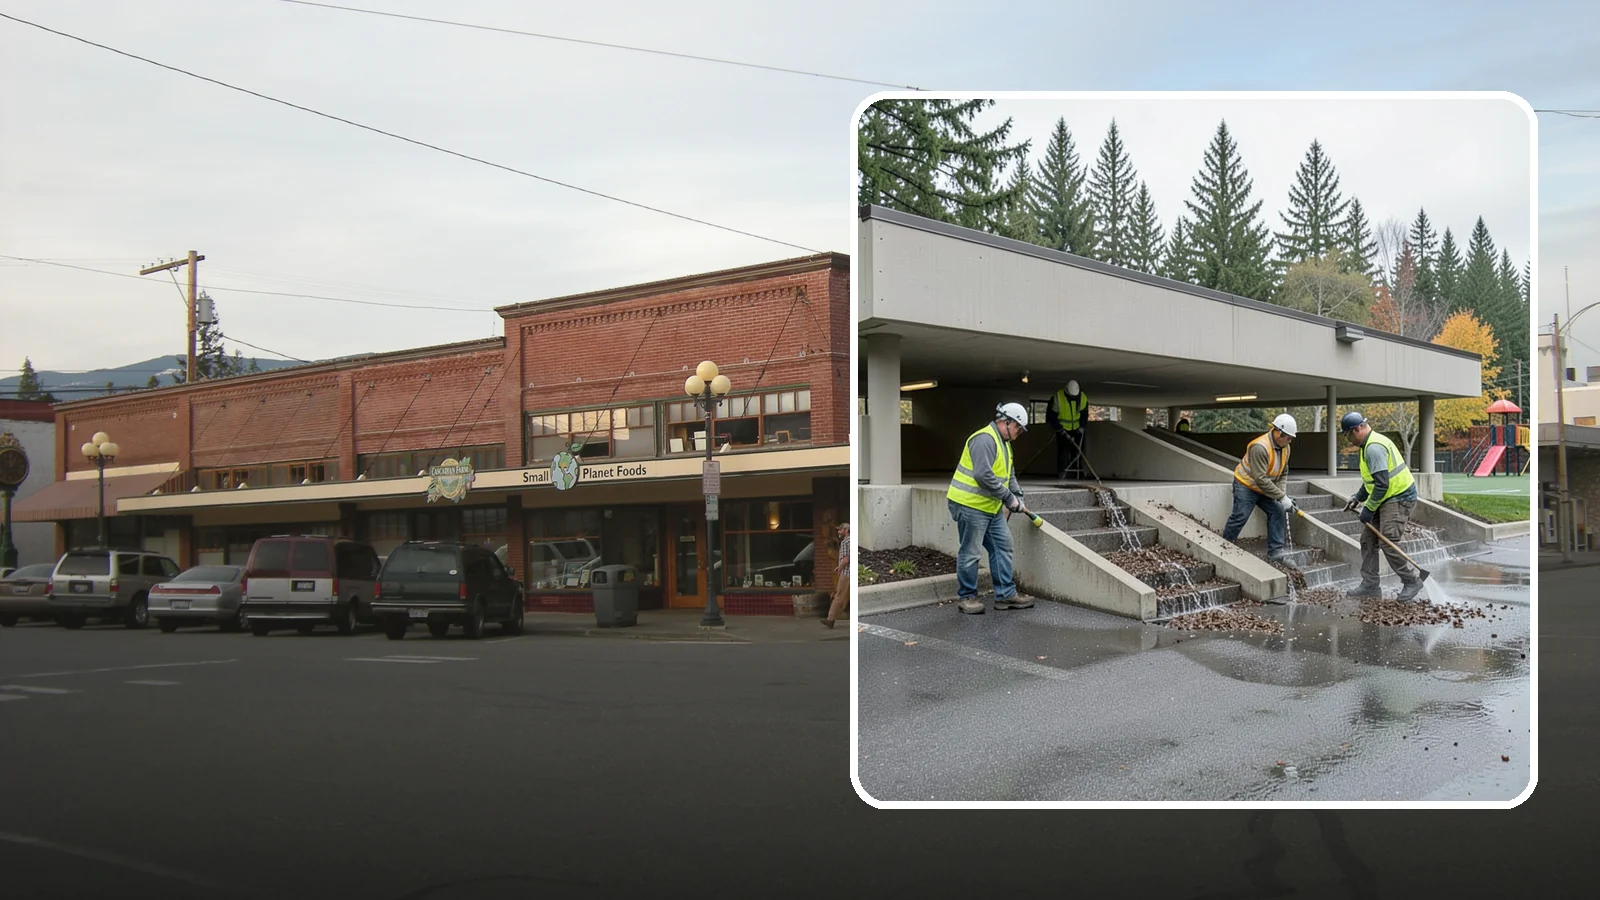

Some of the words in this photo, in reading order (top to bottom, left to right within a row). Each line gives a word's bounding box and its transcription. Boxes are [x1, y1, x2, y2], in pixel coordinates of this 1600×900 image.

[523, 471, 549, 483] Small
[583, 468, 614, 479] Planet
[617, 464, 647, 477] Foods
